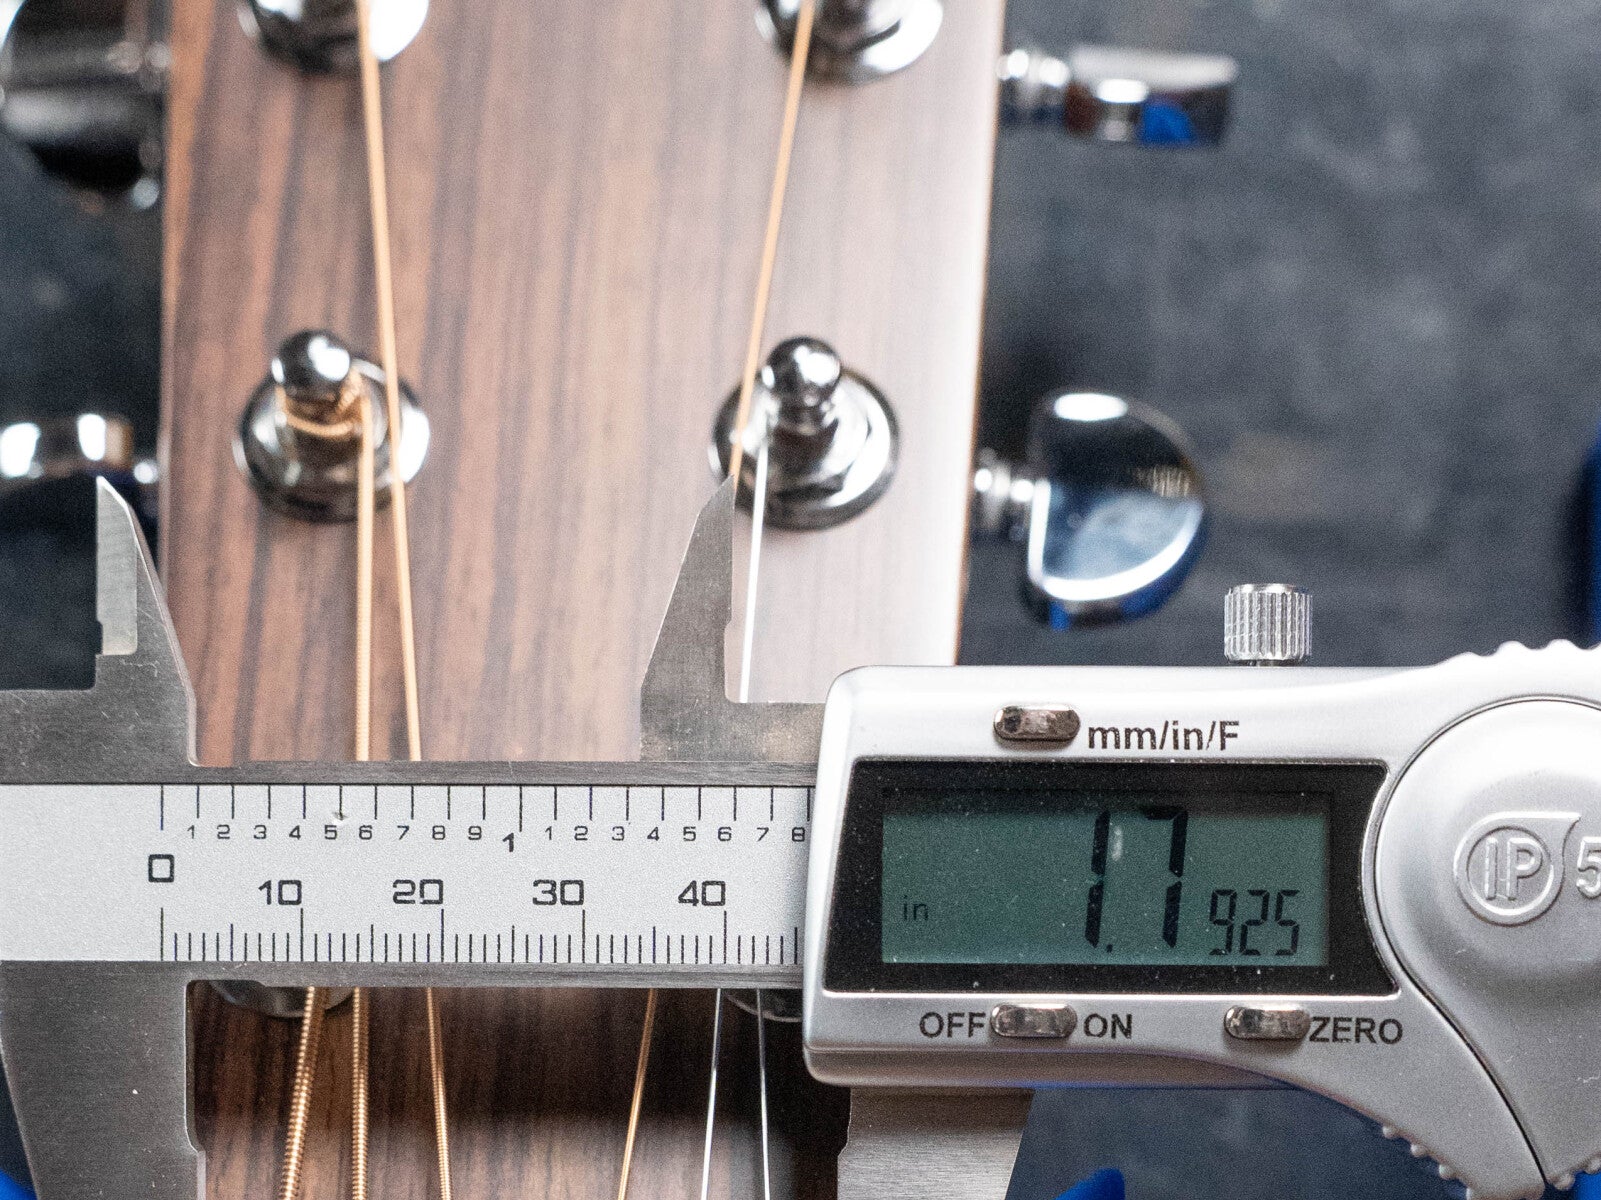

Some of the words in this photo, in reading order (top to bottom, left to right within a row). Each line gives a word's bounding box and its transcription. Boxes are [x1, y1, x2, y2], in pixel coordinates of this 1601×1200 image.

[1088, 721, 1239, 750] mm/in/F
[188, 825, 194, 838] 1
[217, 824, 230, 839] 2
[254, 825, 267, 839] 3
[289, 825, 301, 839] 4
[324, 825, 337, 840] 5
[359, 825, 372, 840] 6
[397, 825, 409, 839] 7
[432, 825, 445, 840] 8
[468, 826, 482, 840] 9
[503, 832, 514, 852] 1
[546, 826, 552, 840] 1
[574, 826, 588, 841] 2
[612, 826, 625, 841] 3
[647, 827, 659, 841] 4
[683, 826, 696, 841] 5
[718, 827, 731, 842] 6
[757, 827, 769, 841] 7
[792, 827, 805, 841] 8
[147, 854, 174, 883] 0
[1485, 837, 1543, 901] IP
[258, 880, 302, 906] 10
[392, 879, 443, 905] 20
[533, 880, 584, 906] 30
[677, 880, 725, 906] 40
[902, 896, 929, 922] in
[918, 1010, 986, 1039] OFF
[1083, 1012, 1133, 1040] ON
[1309, 1014, 1404, 1046] ZERO
